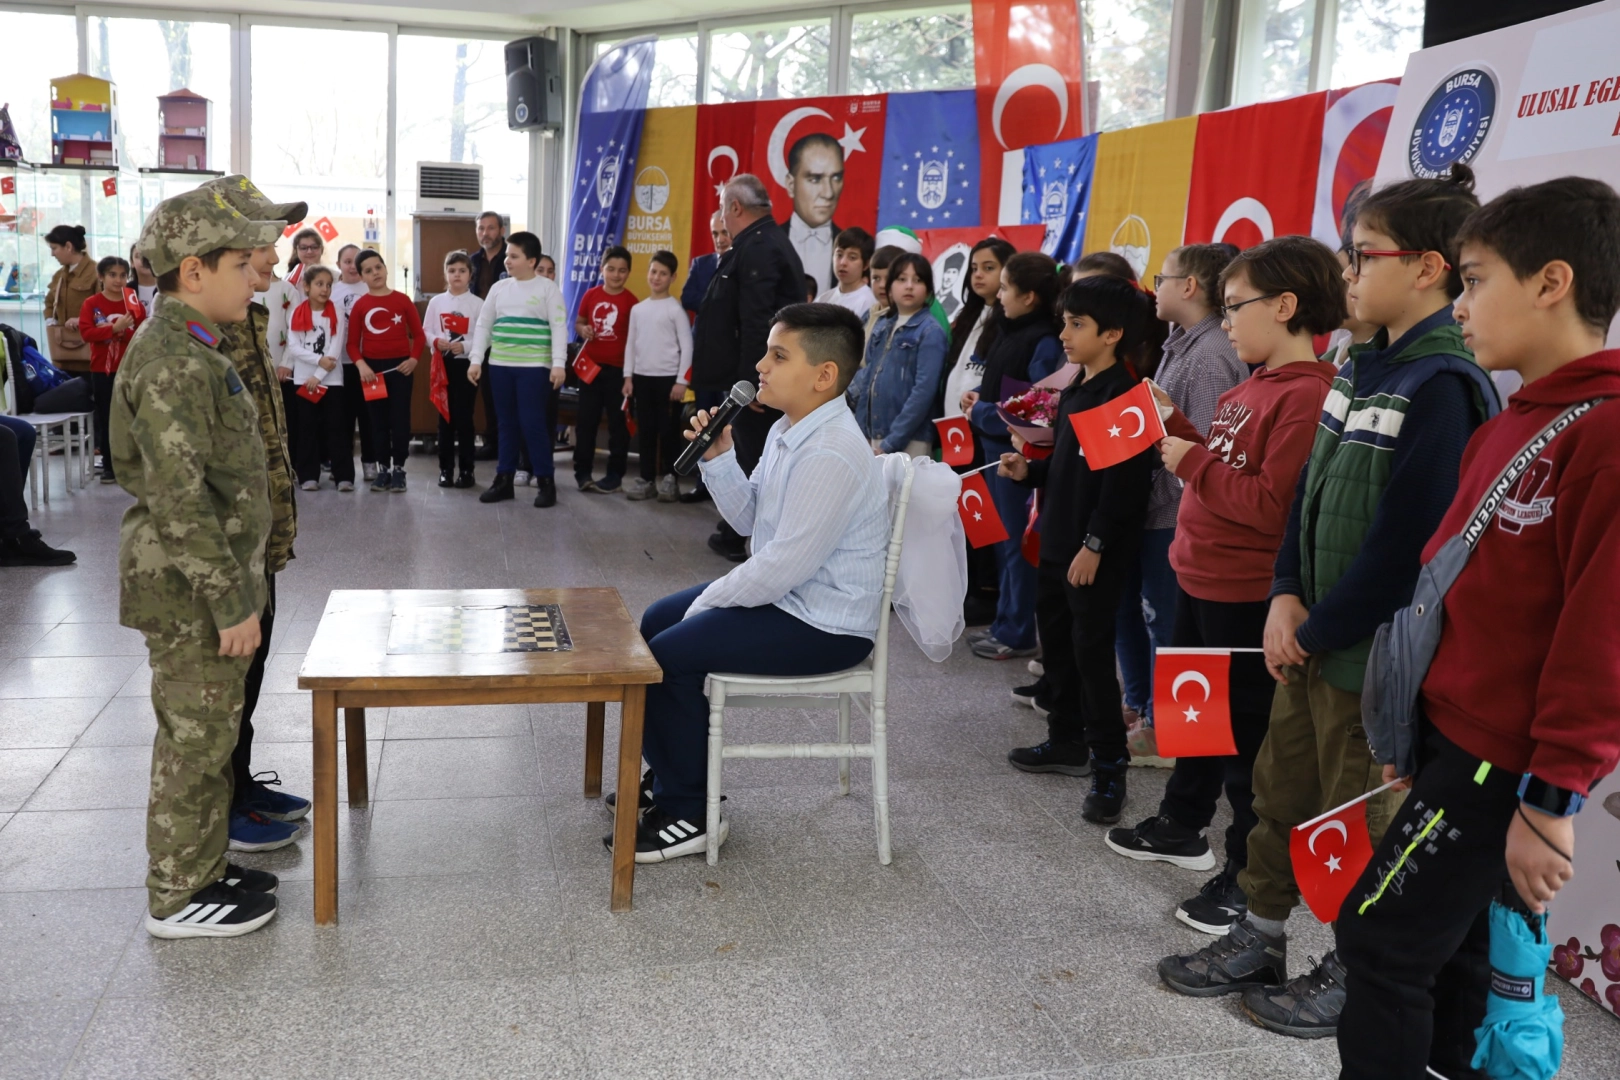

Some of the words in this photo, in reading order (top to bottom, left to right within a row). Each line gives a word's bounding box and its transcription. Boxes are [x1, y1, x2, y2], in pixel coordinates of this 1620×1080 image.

[1446, 73, 1482, 93] BURSA
[1517, 84, 1580, 119] ULUSAL
[628, 216, 671, 231] BURSA
[1413, 800, 1462, 841] FREE
[1416, 818, 1438, 841] TO
